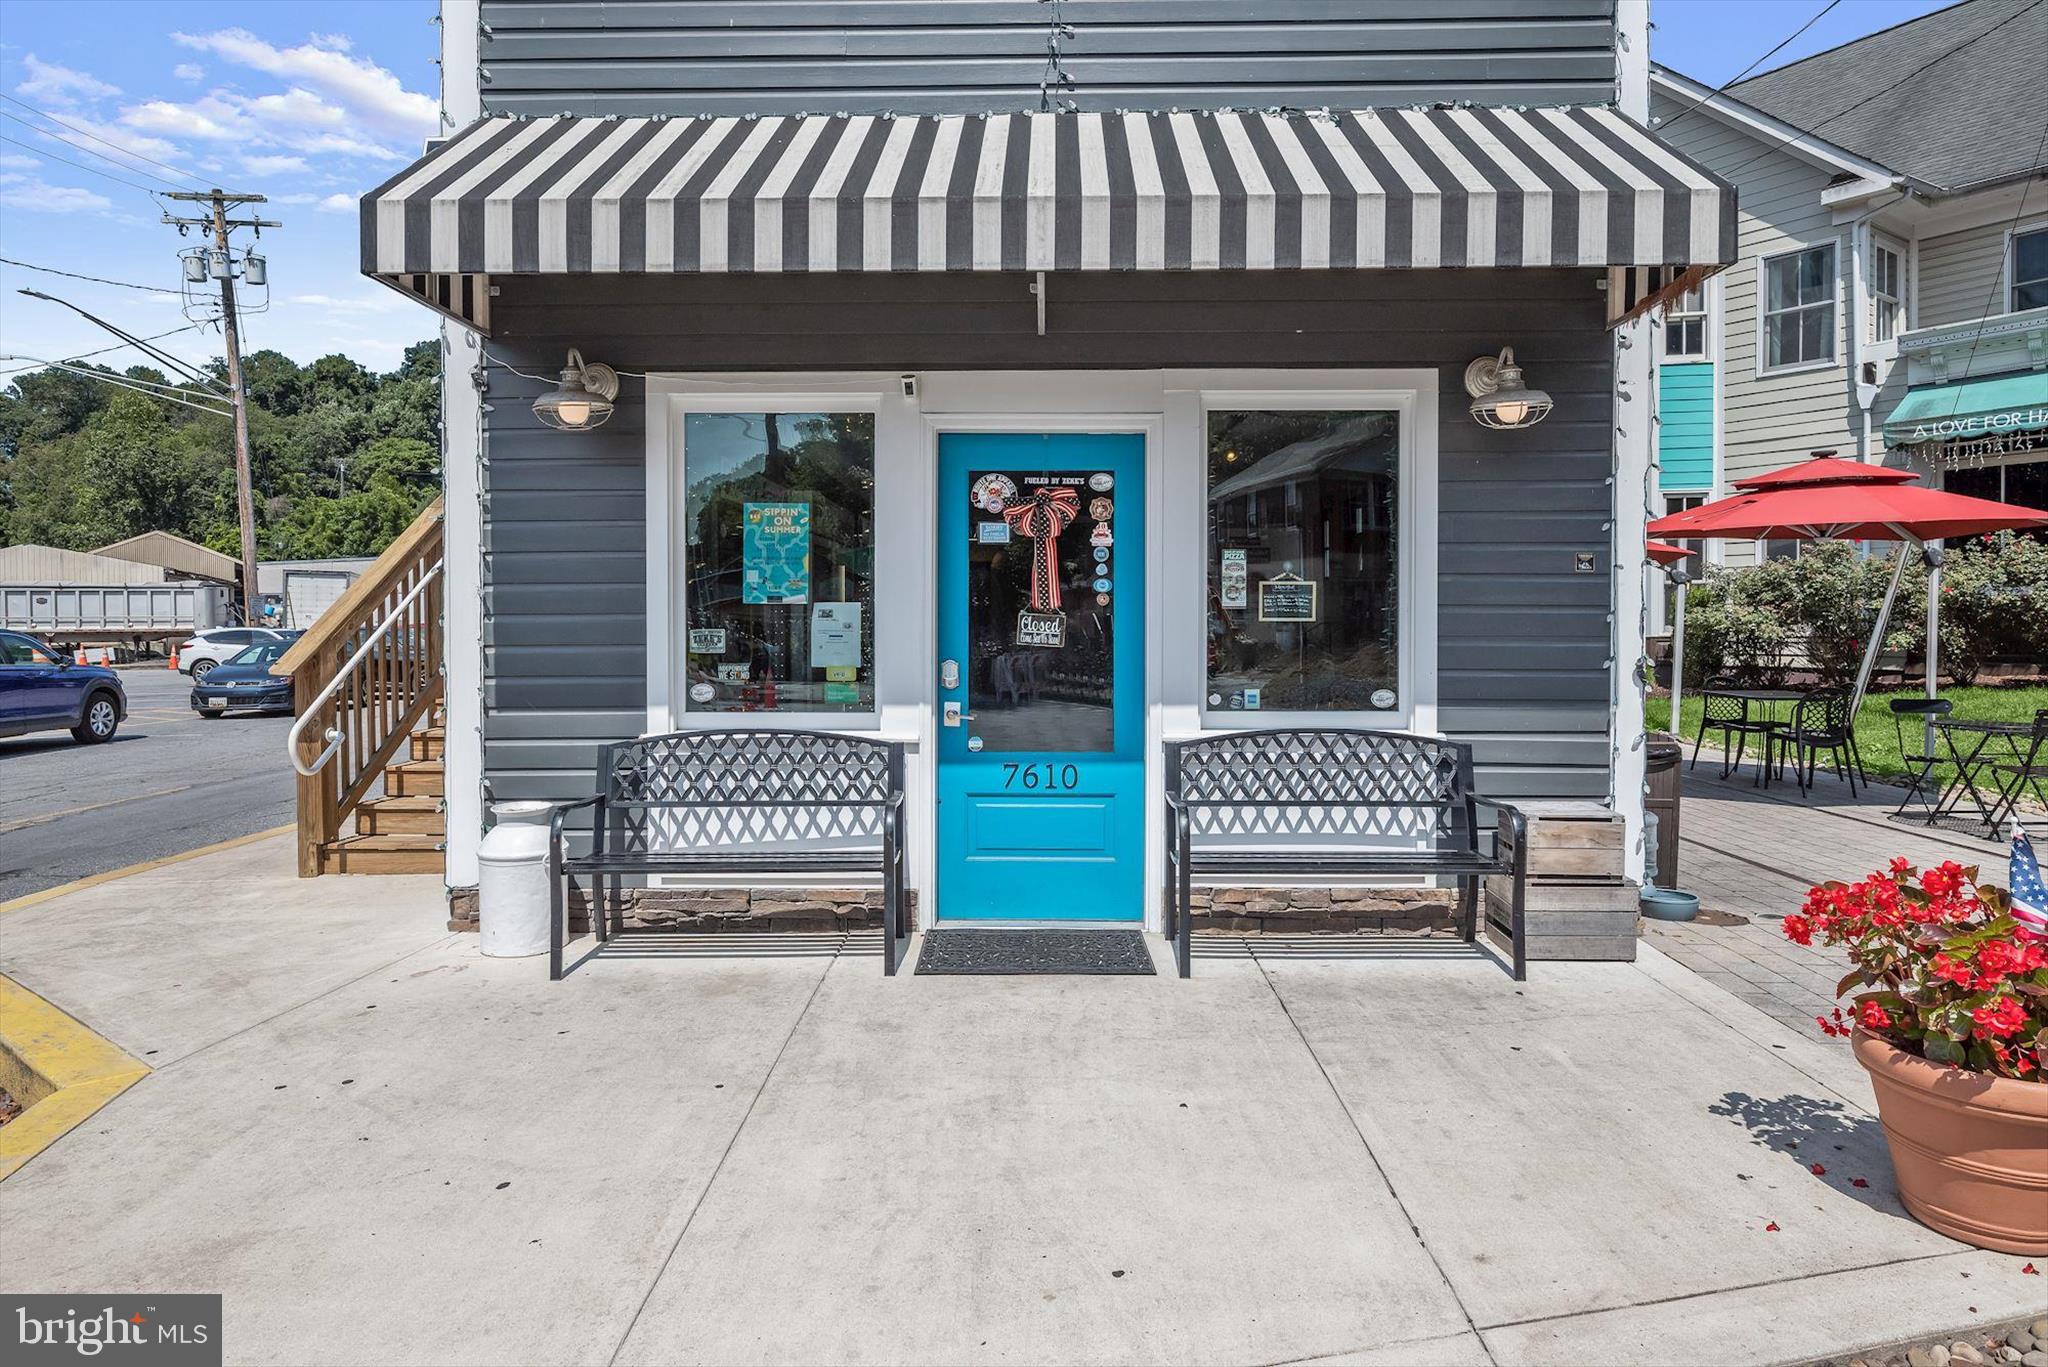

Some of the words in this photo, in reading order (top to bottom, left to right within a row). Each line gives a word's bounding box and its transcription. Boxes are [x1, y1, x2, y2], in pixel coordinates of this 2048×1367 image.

[1913, 424, 1928, 438] A
[1932, 418, 1979, 435] LOVE
[1984, 412, 2022, 429] FOR
[1024, 477, 1050, 485] FUELED
[1051, 477, 1060, 485] BY
[764, 507, 801, 516] SIPPIN'
[774, 516, 792, 526] ON
[764, 526, 801, 534] SUMMER
[1021, 615, 1061, 632] Closed
[729, 671, 750, 680] STND
[1003, 763, 1078, 789] 7610
